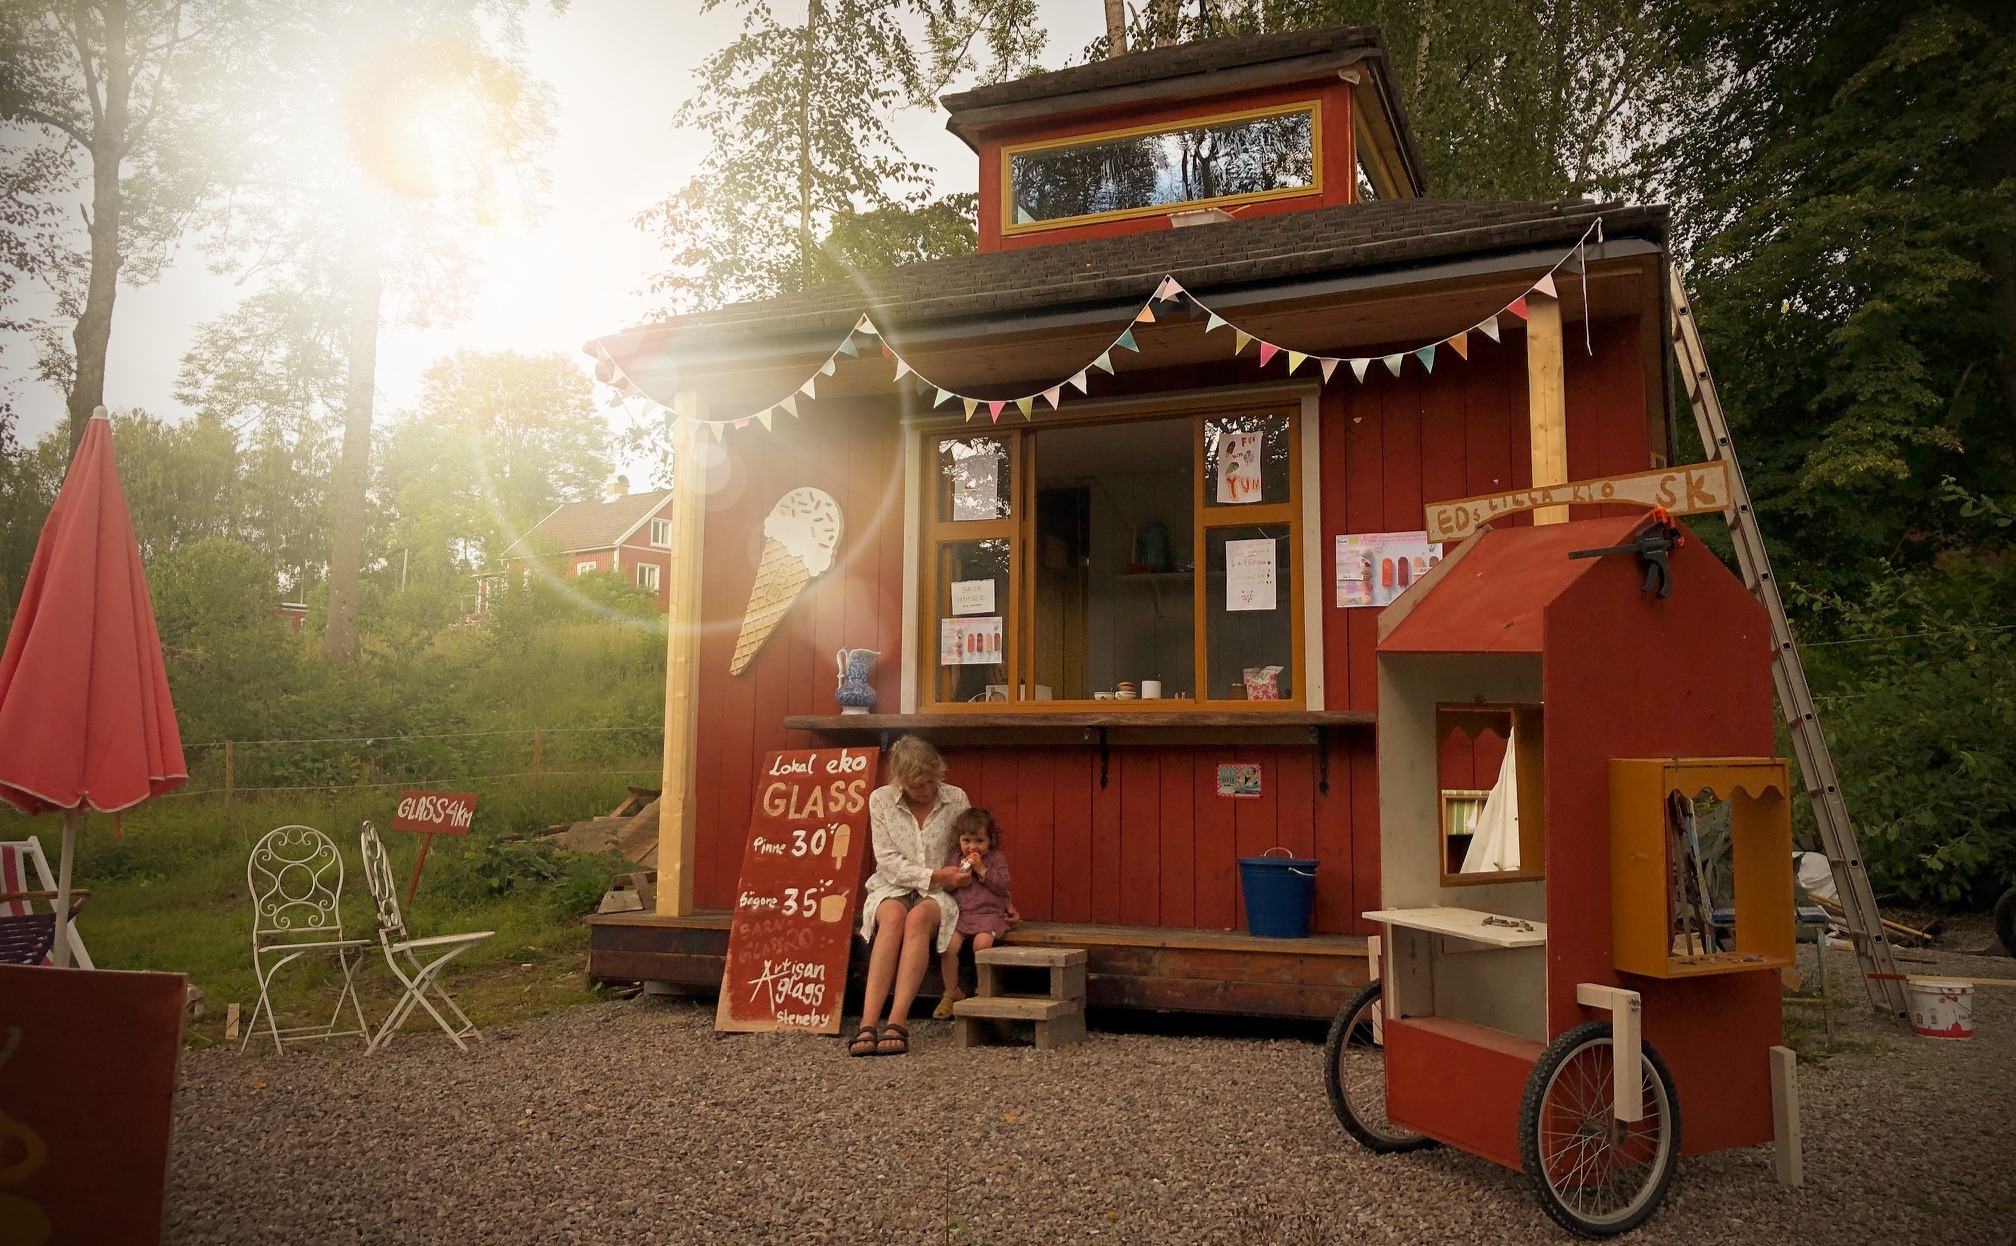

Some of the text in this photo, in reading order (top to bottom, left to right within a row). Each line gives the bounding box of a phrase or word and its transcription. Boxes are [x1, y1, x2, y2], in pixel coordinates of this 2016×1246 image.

[769, 748, 867, 776] Lokal eko
[397, 796, 449, 824] GLASS
[763, 779, 866, 819] GLASS
[747, 957, 826, 1016] Artisan
[776, 1007, 830, 1028] steneby
